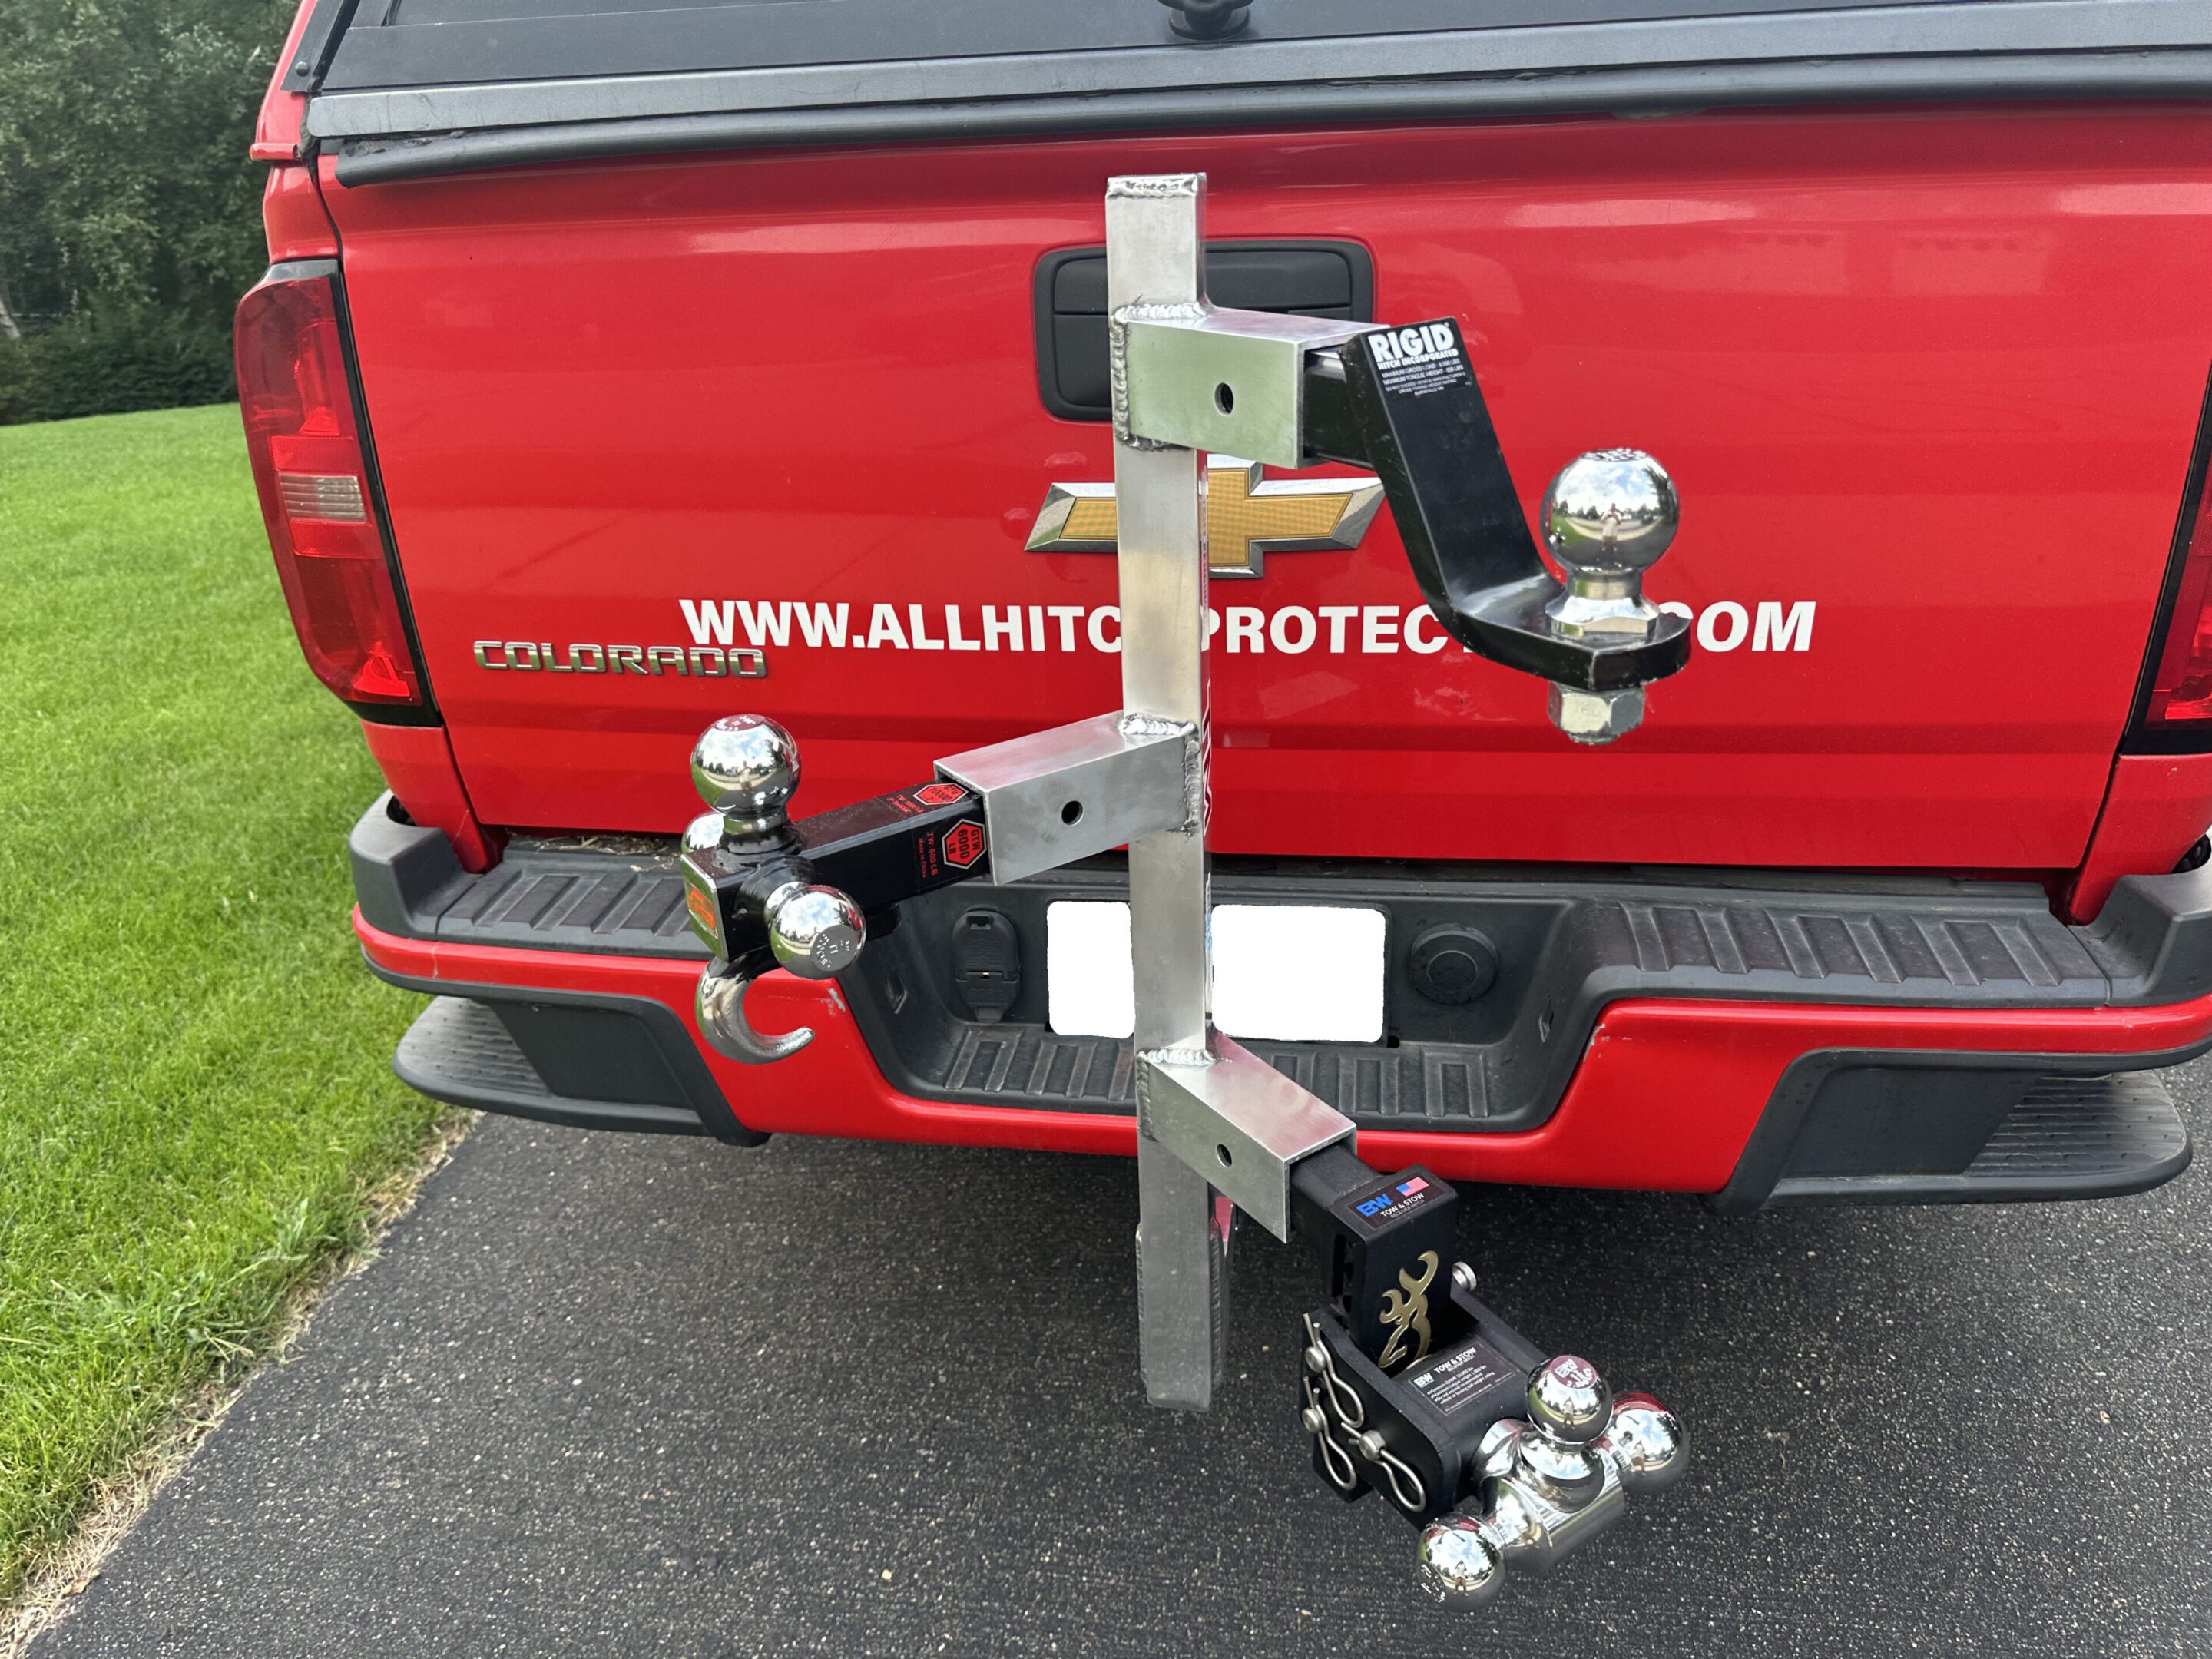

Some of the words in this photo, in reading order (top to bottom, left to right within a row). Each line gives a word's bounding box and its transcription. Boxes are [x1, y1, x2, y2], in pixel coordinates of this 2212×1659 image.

[1368, 323, 1454, 362] RIGID
[1401, 349, 1459, 366] INCORPORATED
[472, 639, 768, 679] COLORADO
[949, 843, 956, 854] LB
[958, 829, 970, 859] 6000
[971, 830, 981, 851] GTW
[930, 863, 939, 876] LB
[1380, 1205, 1399, 1217] TOW
[1403, 1193, 1425, 1206] STOW
[1434, 1362, 1452, 1374] TOW
[1457, 1347, 1476, 1360] STOW
